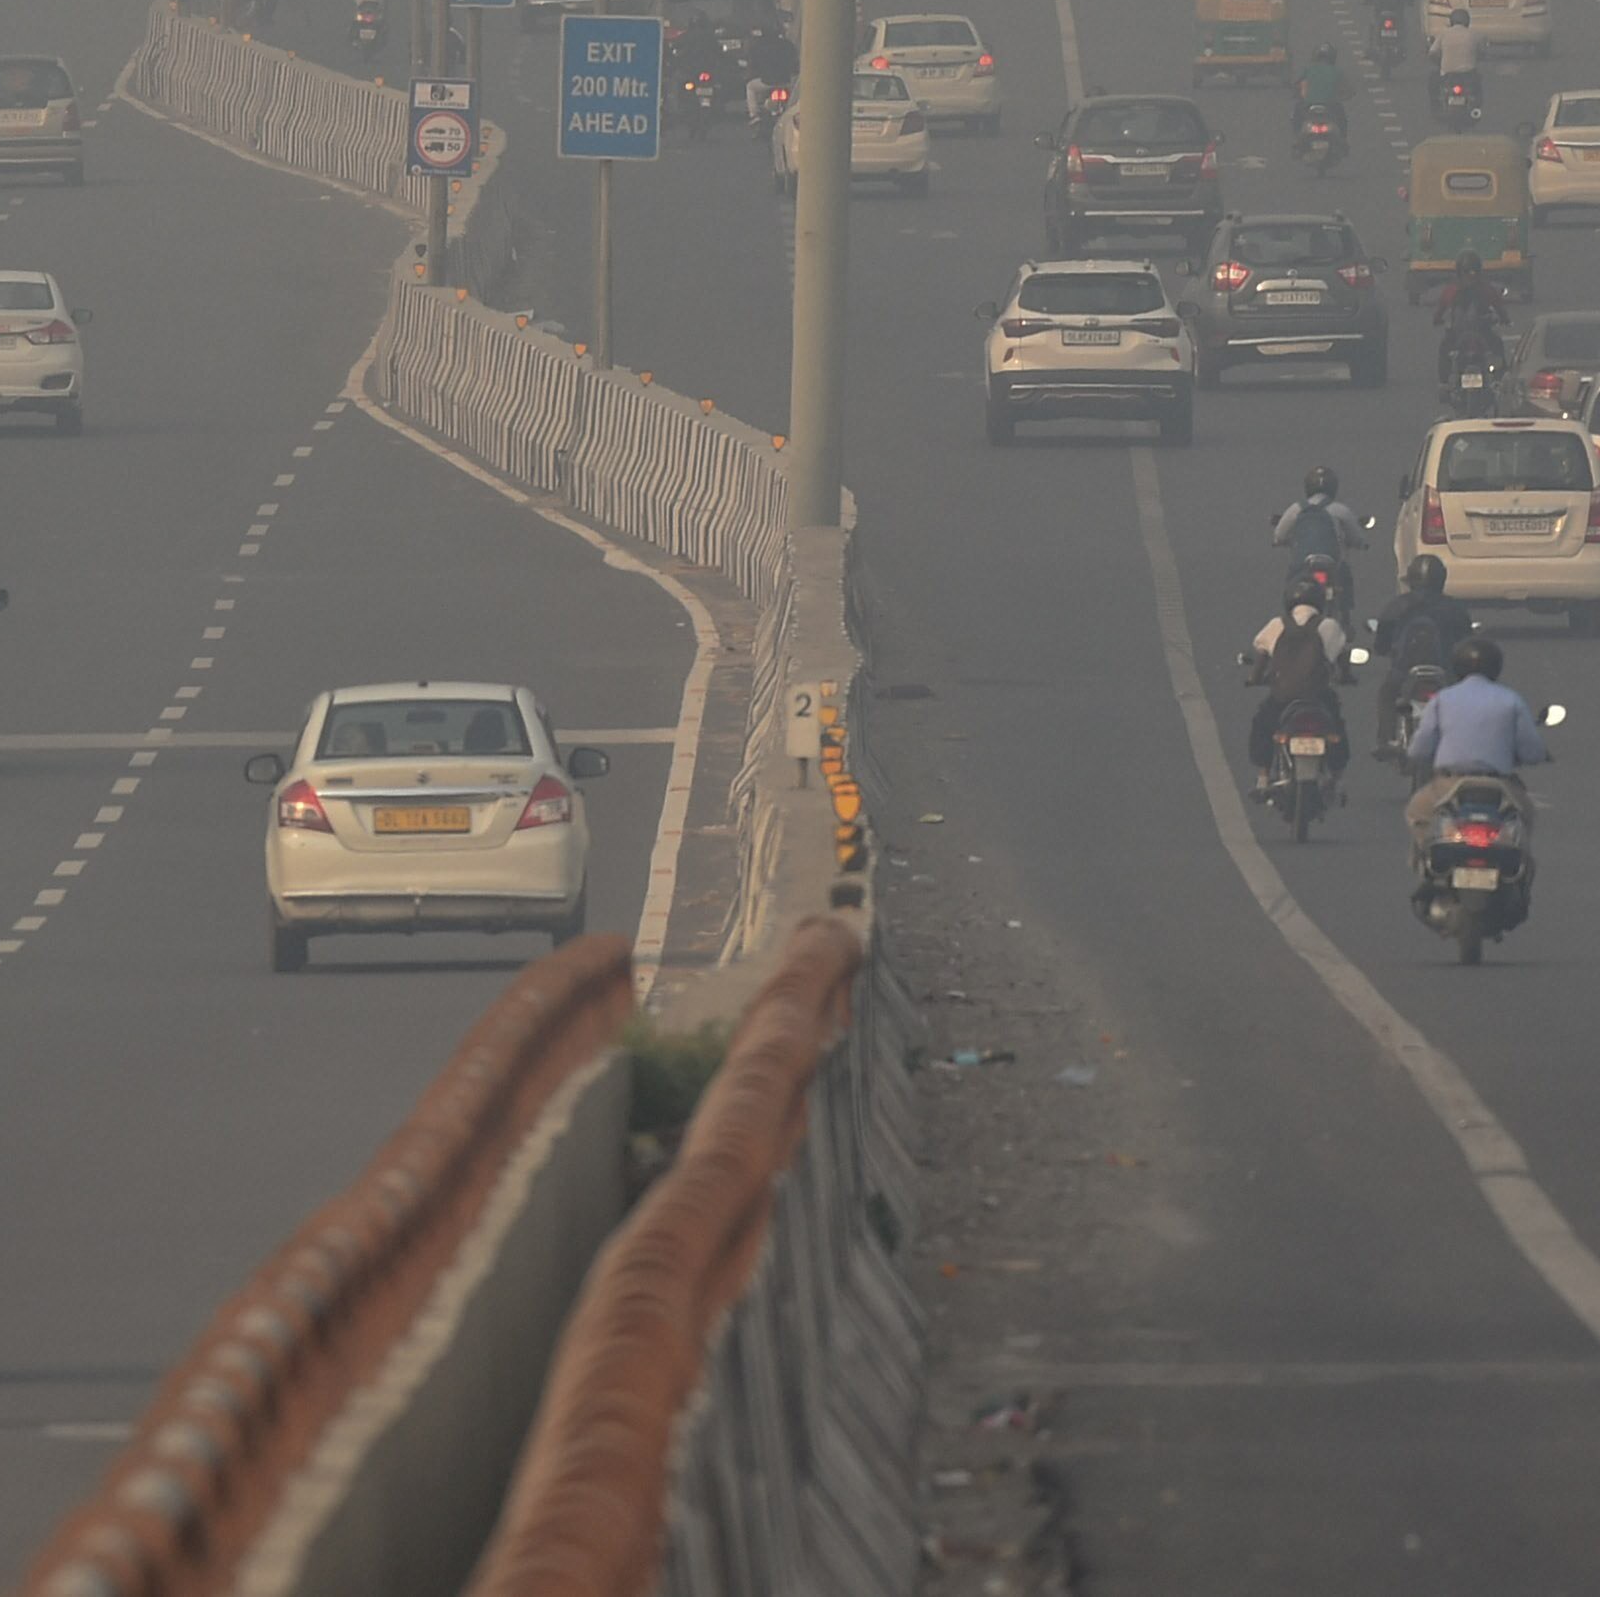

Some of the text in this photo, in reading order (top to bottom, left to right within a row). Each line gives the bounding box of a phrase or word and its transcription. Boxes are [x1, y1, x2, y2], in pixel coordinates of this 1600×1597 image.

[587, 42, 637, 63] EXIT
[570, 75, 650, 99] 200 Mtr.
[448, 128, 461, 136] 70
[568, 112, 649, 135] AHEAD
[447, 143, 461, 152] 50
[794, 693, 812, 718] 2
